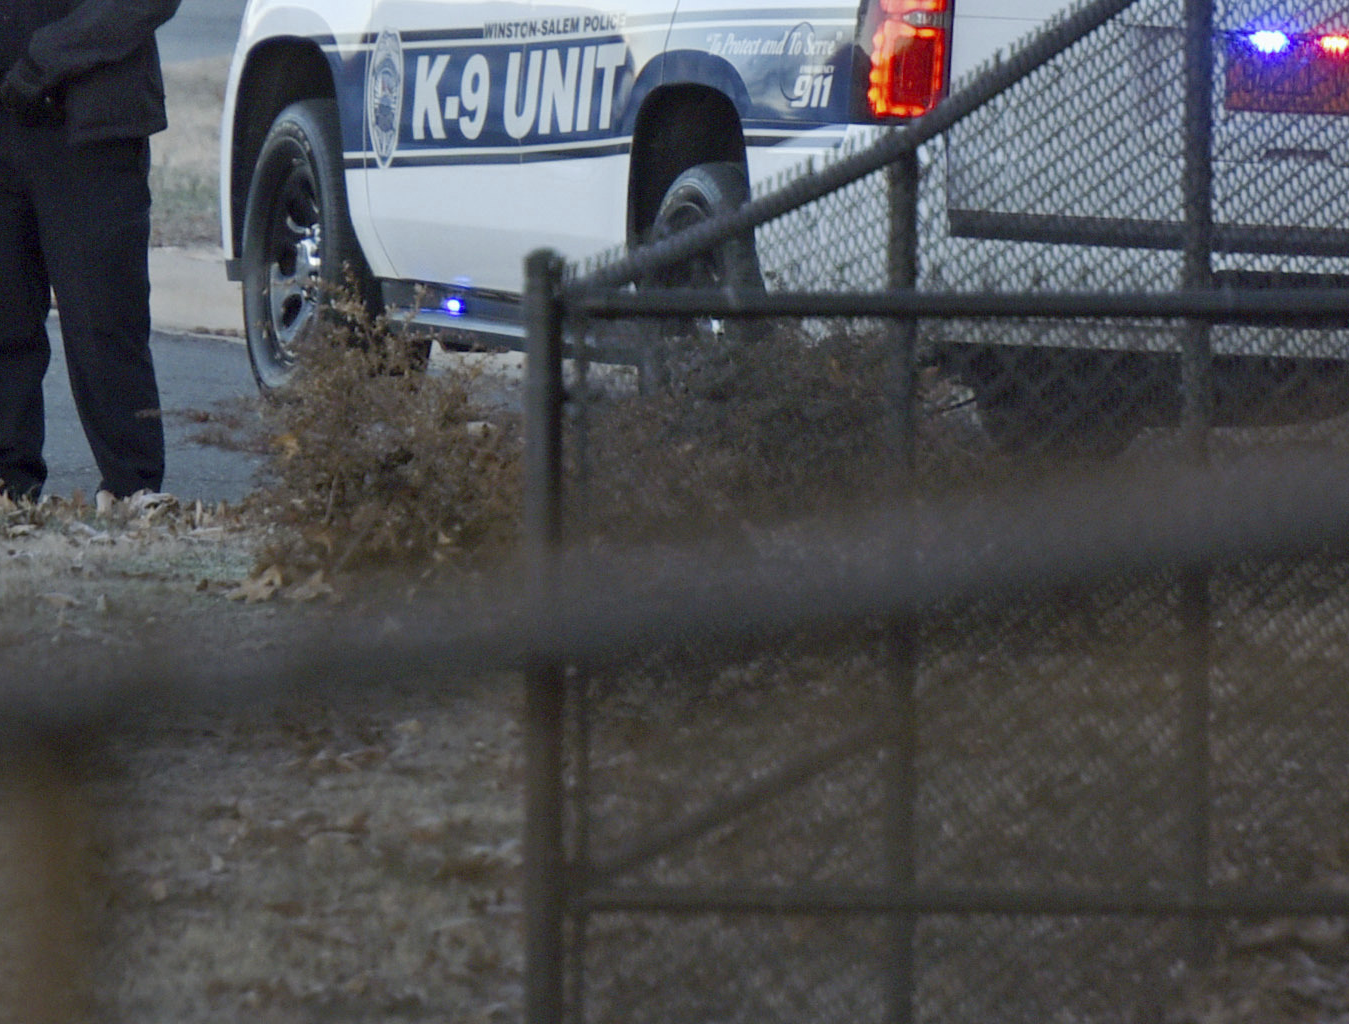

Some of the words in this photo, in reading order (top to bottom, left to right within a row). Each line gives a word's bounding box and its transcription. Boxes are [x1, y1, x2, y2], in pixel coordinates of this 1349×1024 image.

[483, 15, 581, 40] WINSTON-SALEM
[582, 13, 627, 33] POLICE
[720, 32, 763, 56] Protect
[761, 31, 789, 56] and
[412, 53, 491, 141] K-9
[503, 42, 627, 140] UNIT
[790, 74, 834, 109] 911
